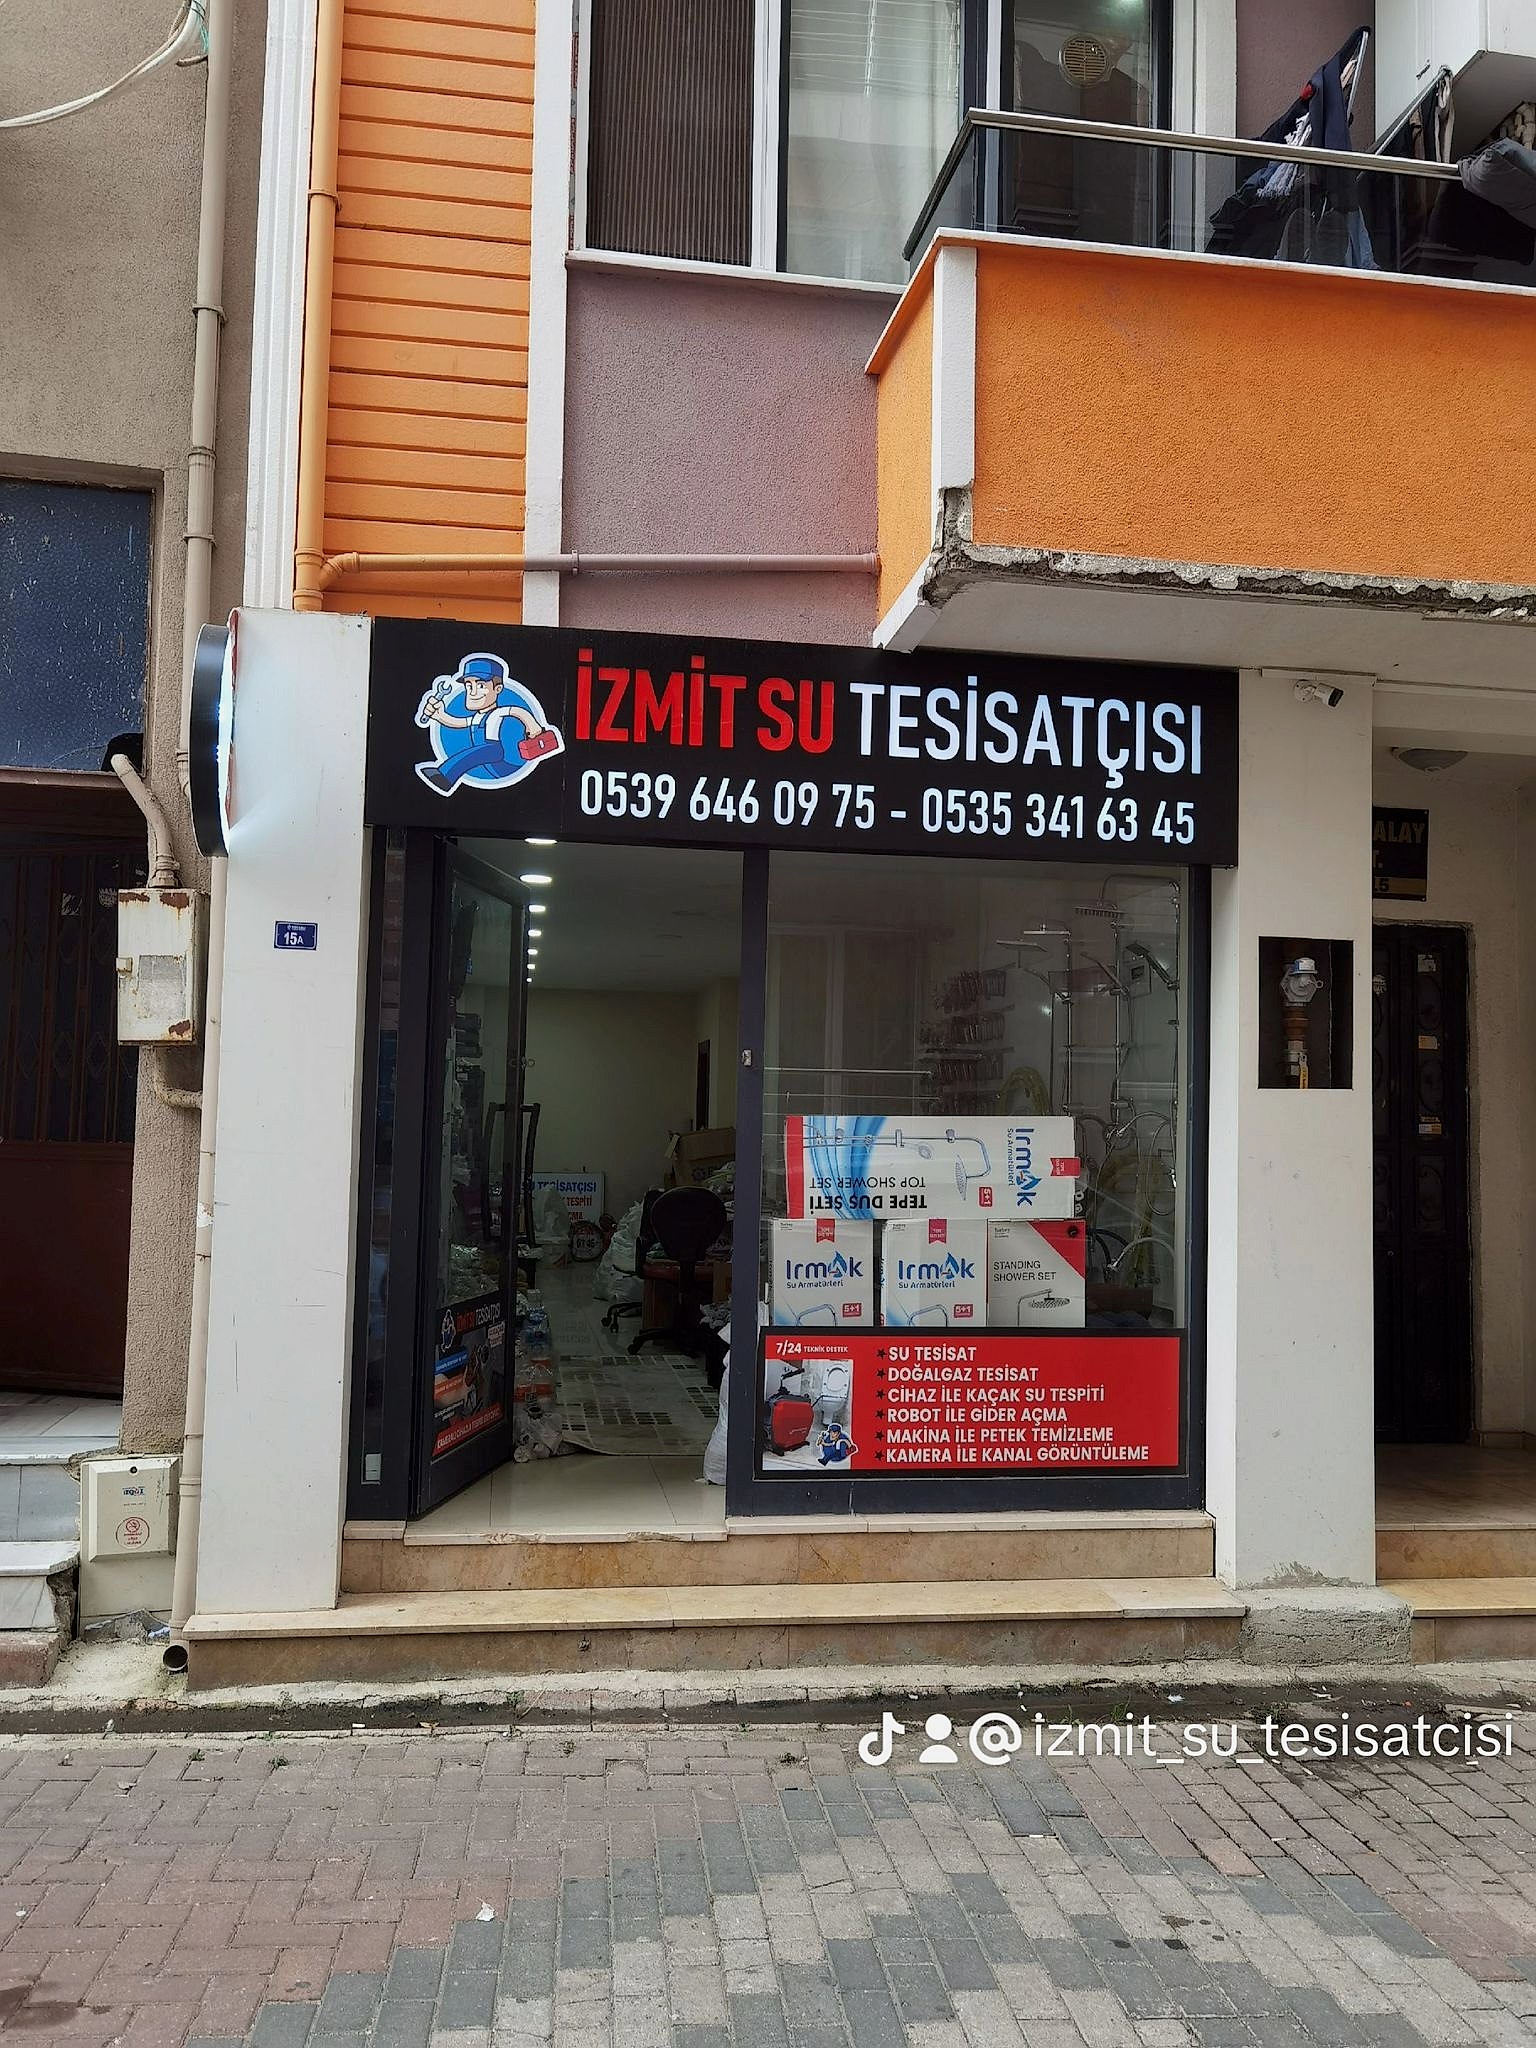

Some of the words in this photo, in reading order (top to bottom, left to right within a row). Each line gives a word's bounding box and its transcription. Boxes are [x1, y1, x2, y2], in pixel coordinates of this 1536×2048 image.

[576, 648, 747, 748] İZMİT
[756, 677, 834, 754] SU
[850, 675, 1201, 789] TESİSATÇISI
[580, 769, 676, 819] 0539
[689, 776, 760, 823] 646
[773, 780, 819, 827] 09
[832, 783, 876, 830] 75
[922, 787, 1012, 836] 0535
[1025, 793, 1084, 839] 341
[1096, 797, 1138, 842] 63
[1151, 800, 1195, 845] 45
[283, 931, 304, 945] 15A
[809, 1177, 832, 1189] SET
[838, 1176, 896, 1189] SHOWER
[901, 1176, 926, 1188] TOP
[809, 1195, 843, 1215] SETİ
[849, 1191, 883, 1209] DUŞ
[889, 1194, 928, 1209] TEPE
[993, 1260, 1041, 1270] STANDING
[993, 1271, 1035, 1282] SHOWER
[1037, 1271, 1057, 1281] SET
[844, 1304, 860, 1312] 5+1
[955, 1305, 971, 1313] 5+1
[775, 1339, 802, 1356] 7/24
[803, 1344, 825, 1353] TEKNİK
[826, 1345, 849, 1353] DESTEK
[888, 1346, 910, 1361] SU
[914, 1343, 977, 1361] TESİSAT
[888, 1363, 972, 1382] DOĞALGAZ
[976, 1364, 1039, 1382] TESİSAT
[888, 1385, 937, 1403] CİHAZ
[941, 1385, 964, 1403] İLE
[966, 1387, 1021, 1406] KAÇAK
[1025, 1388, 1046, 1402] SU
[1050, 1384, 1105, 1402] TESPİTİ
[887, 1408, 942, 1423] ROBOT
[945, 1405, 966, 1422] İLE
[970, 1404, 1016, 1422] GİDER
[1020, 1407, 1068, 1426] AÇMA
[886, 1425, 951, 1443] MAKİNA
[955, 1425, 975, 1443] İLE
[980, 1427, 1027, 1443] PETEK
[1031, 1424, 1114, 1442] TEMİZLEME
[886, 1448, 952, 1463] KAMERA
[956, 1445, 977, 1463] İLE
[982, 1447, 1032, 1462] KANAL
[1037, 1443, 1149, 1461] GÖRÜNTÜLEME
